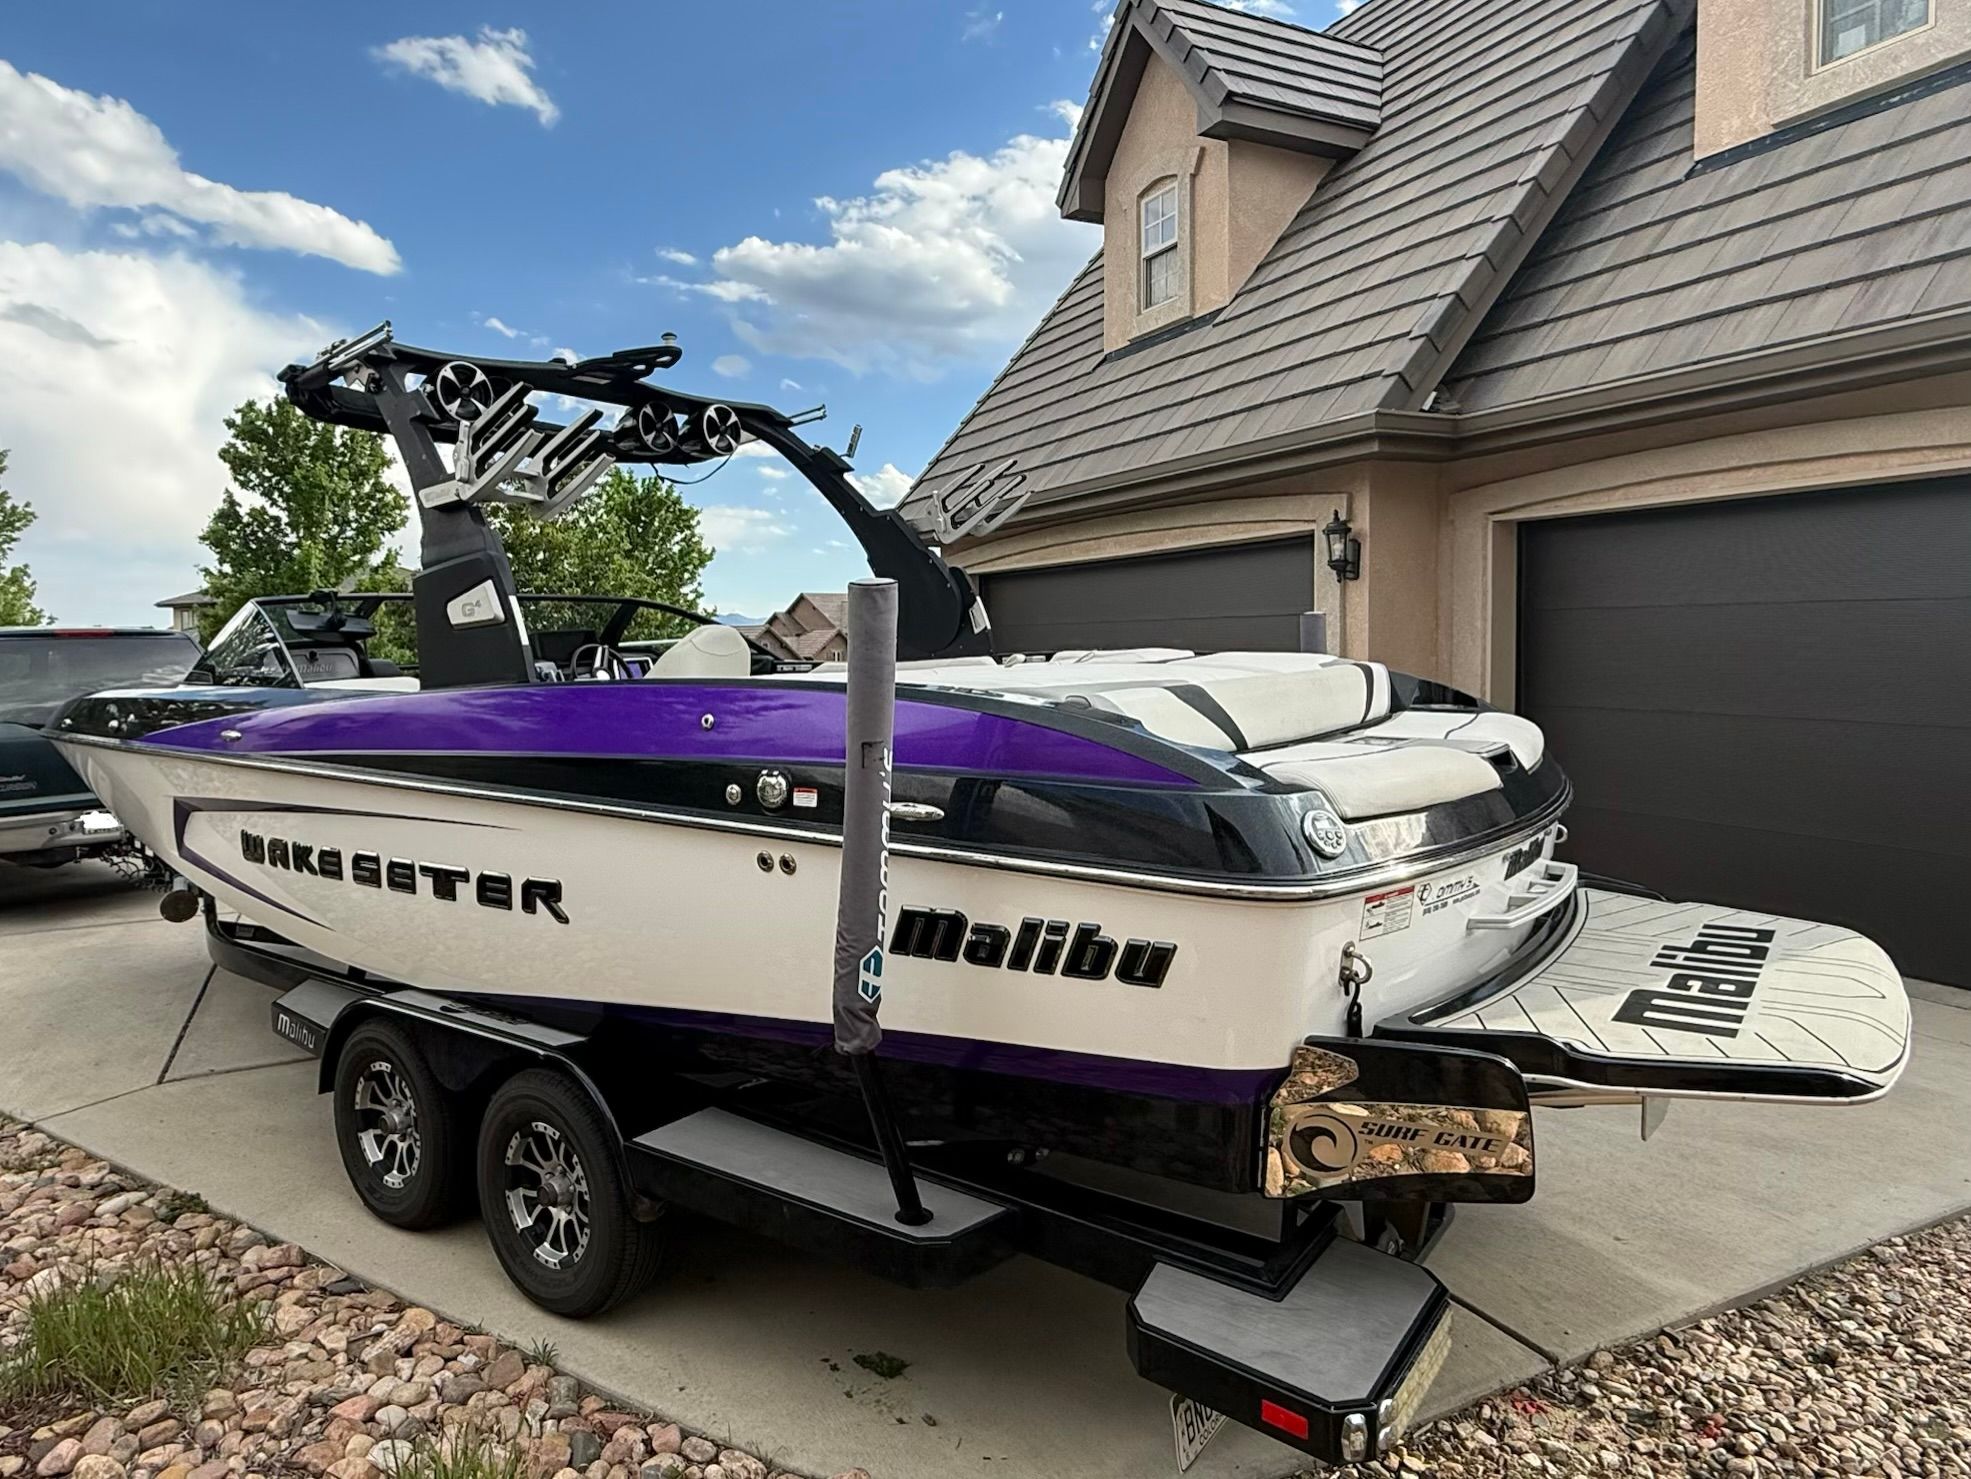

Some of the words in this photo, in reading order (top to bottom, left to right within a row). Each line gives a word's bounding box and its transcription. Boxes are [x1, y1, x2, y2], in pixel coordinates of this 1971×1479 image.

[1611, 923, 1777, 1039] Malibu
[277, 1013, 316, 1049] Malibu
[1358, 1121, 1430, 1141] SURF
[1433, 1131, 1503, 1153] GATE
